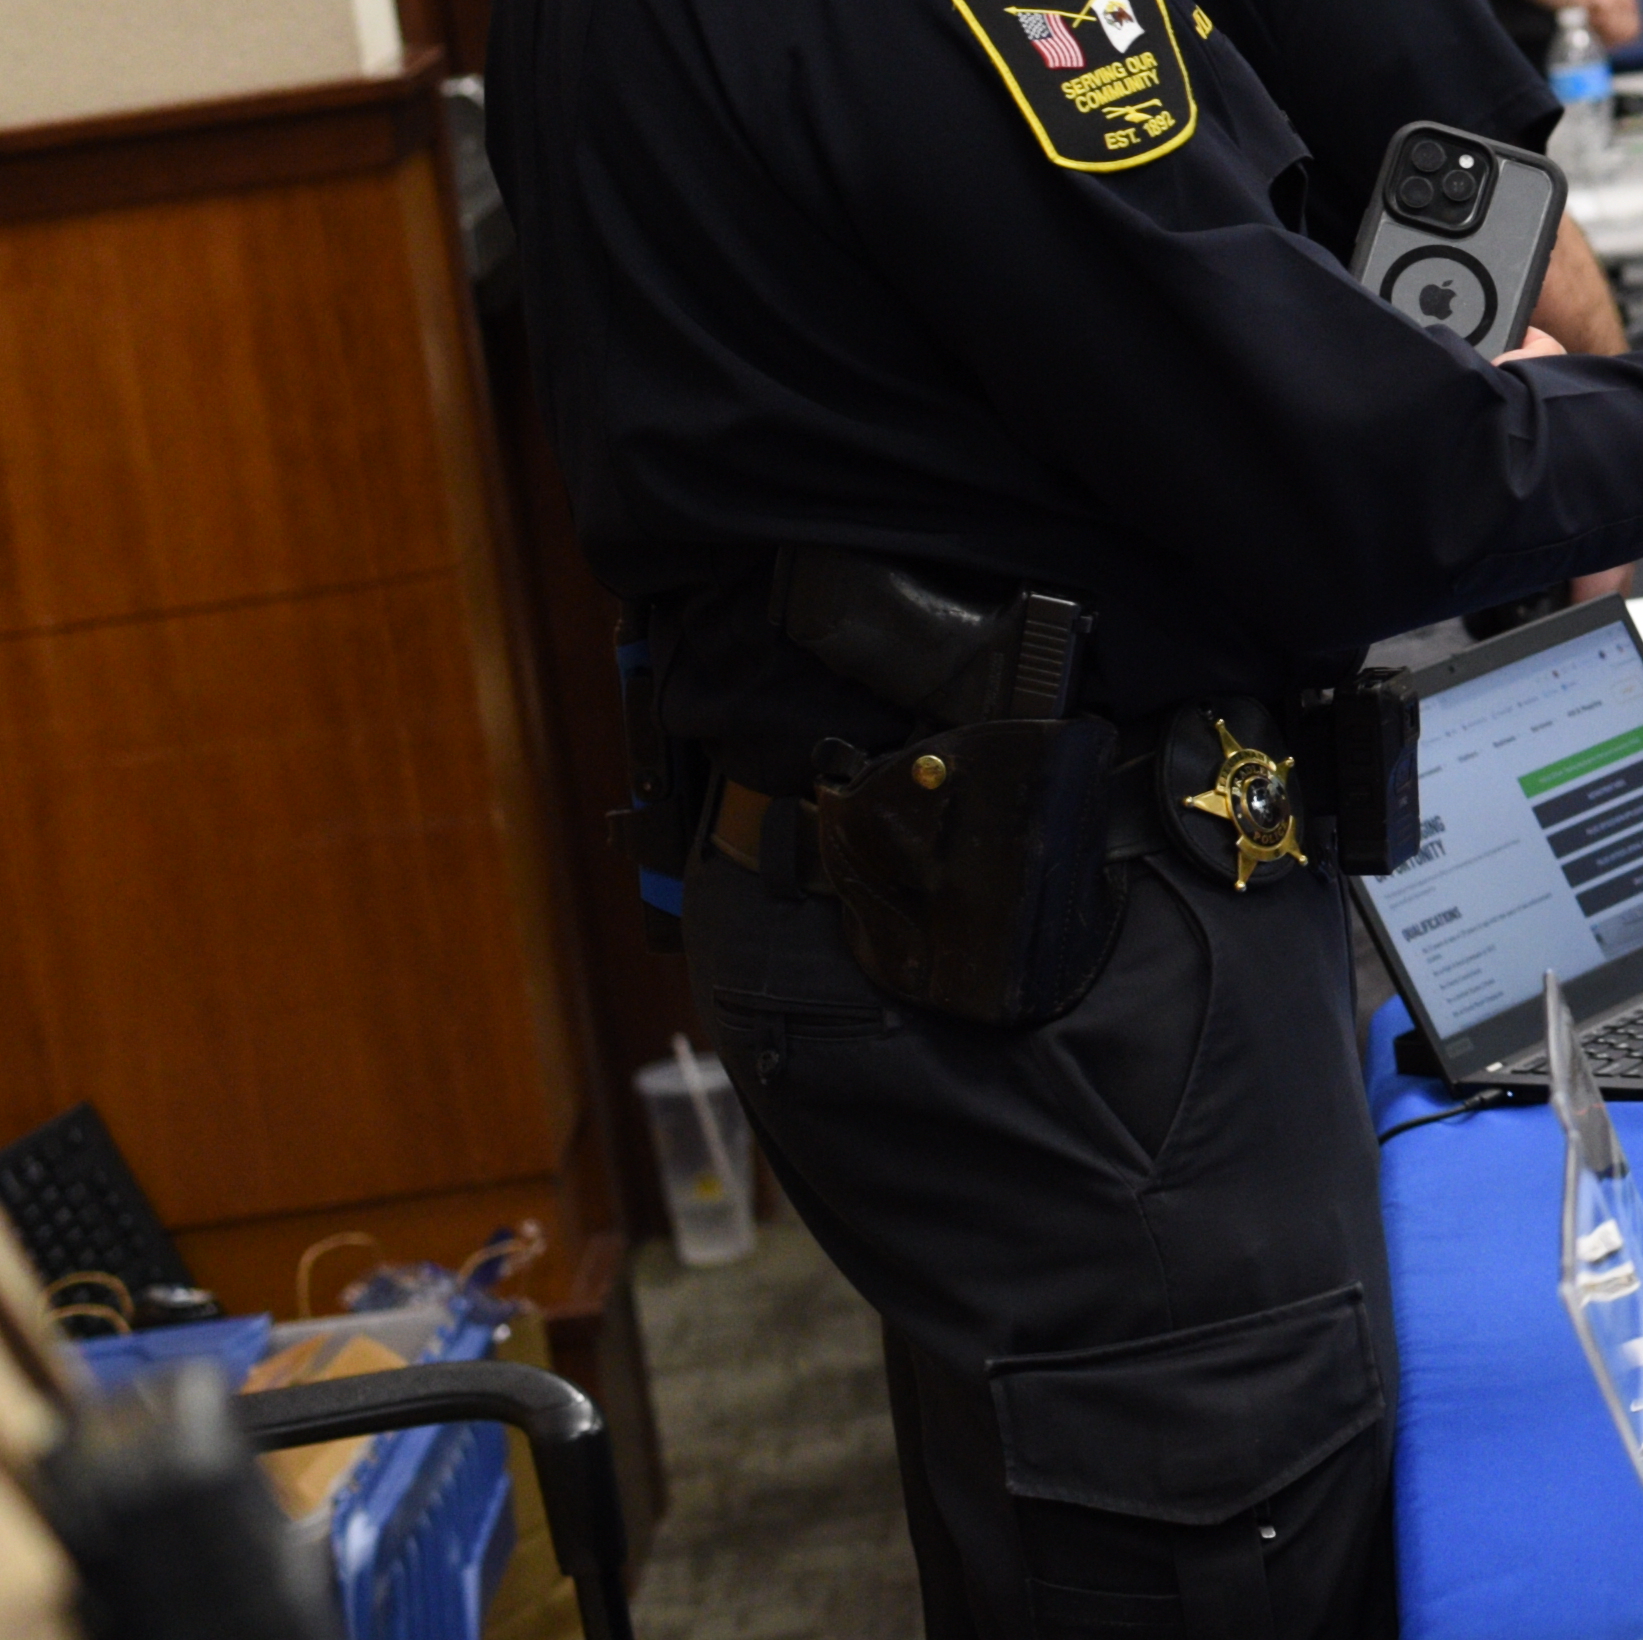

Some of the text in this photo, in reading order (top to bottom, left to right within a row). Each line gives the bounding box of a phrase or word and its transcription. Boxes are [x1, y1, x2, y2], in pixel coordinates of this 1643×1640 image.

[1061, 51, 1158, 100] SERVING OUR
[1075, 69, 1159, 113] COMMUNITY
[1104, 111, 1175, 150] EST. 1892
